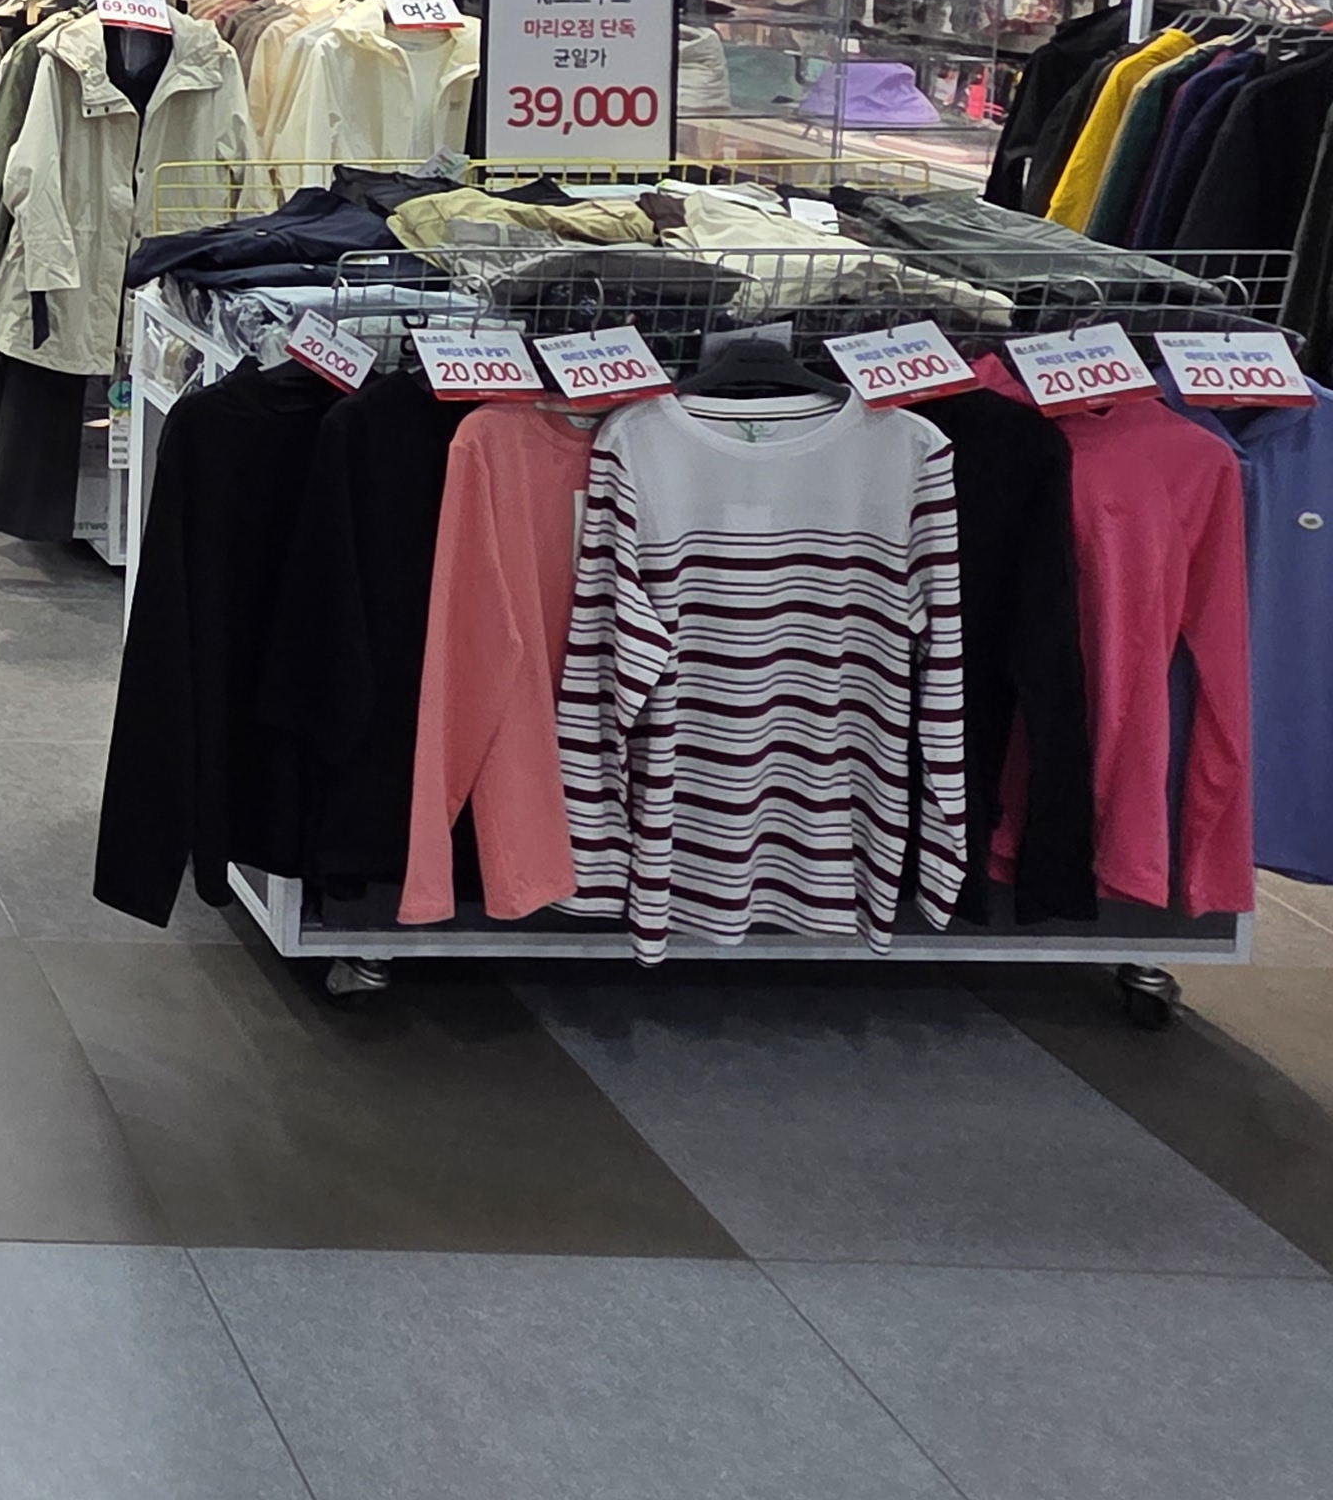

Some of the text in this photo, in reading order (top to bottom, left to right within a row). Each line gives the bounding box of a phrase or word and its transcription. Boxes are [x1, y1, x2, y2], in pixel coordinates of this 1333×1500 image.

[402, 1, 447, 21] 여성
[524, 18, 636, 39] 마리오점 단독
[553, 48, 608, 69] 균일가
[507, 85, 659, 135] 39,000
[300, 334, 358, 378] 20,000
